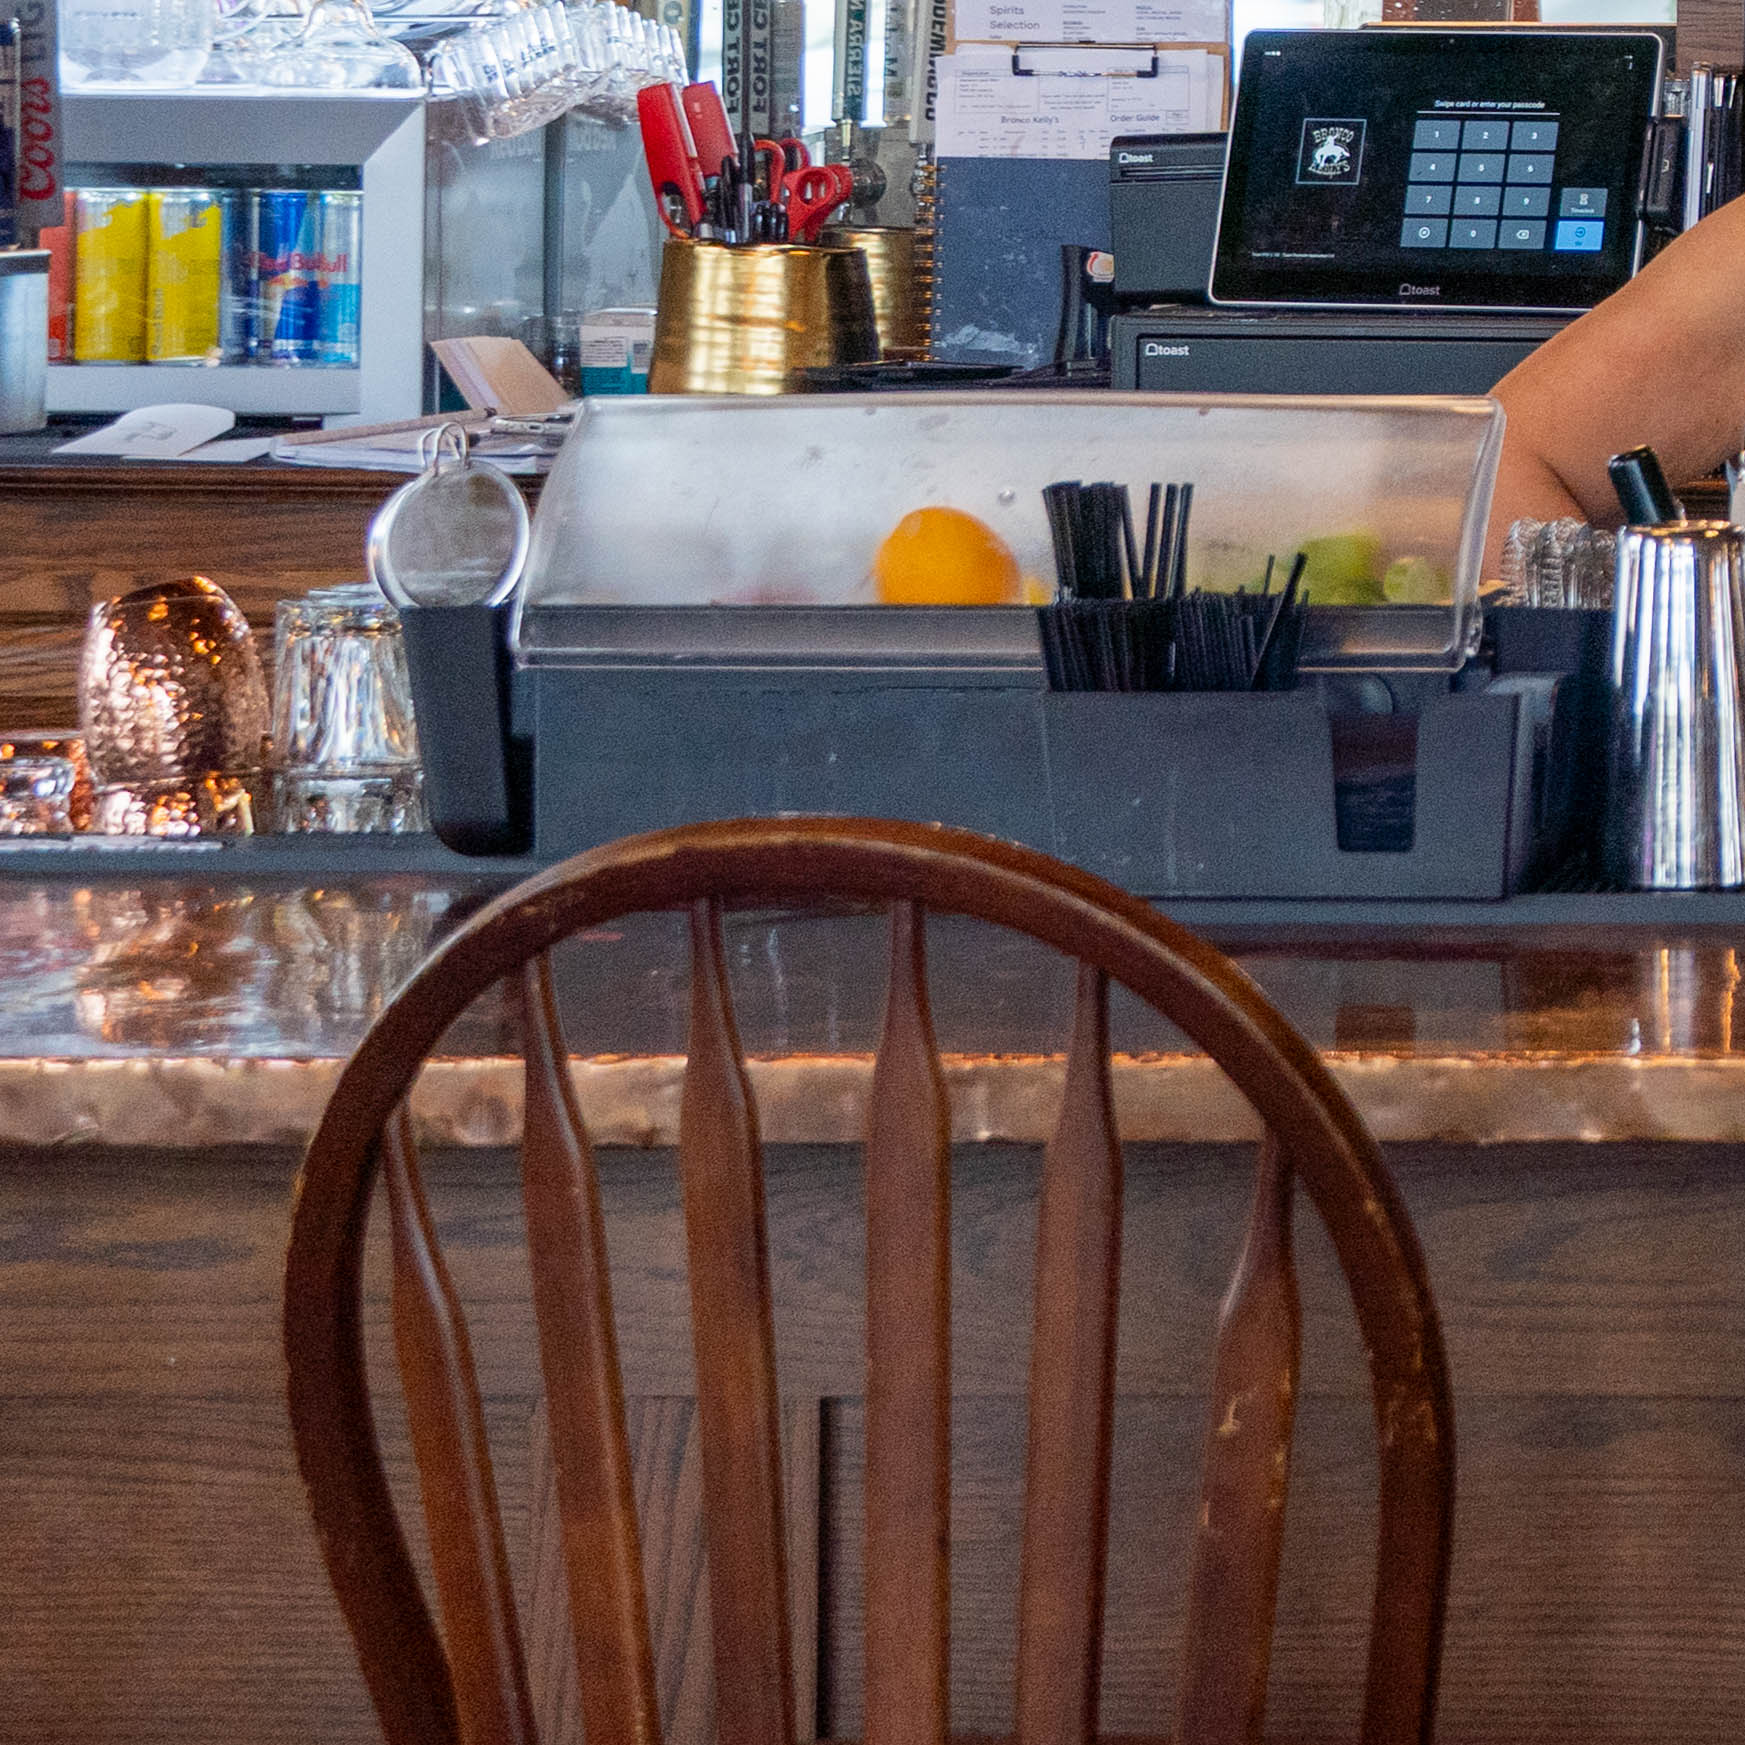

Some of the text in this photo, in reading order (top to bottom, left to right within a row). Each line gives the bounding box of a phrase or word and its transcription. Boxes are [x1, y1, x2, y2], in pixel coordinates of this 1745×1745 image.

[990, 6, 1024, 16] Spirits
[990, 20, 1040, 30] Selection
[1434, 100, 1453, 109] Swipe
[1513, 101, 1546, 109] passcode
[1001, 116, 1031, 124] Bronco
[1110, 114, 1133, 122] Order
[1136, 114, 1160, 122] Guide
[20, 76, 56, 202] Coors
[1411, 285, 1440, 295] toast
[1158, 343, 1189, 356] toast
